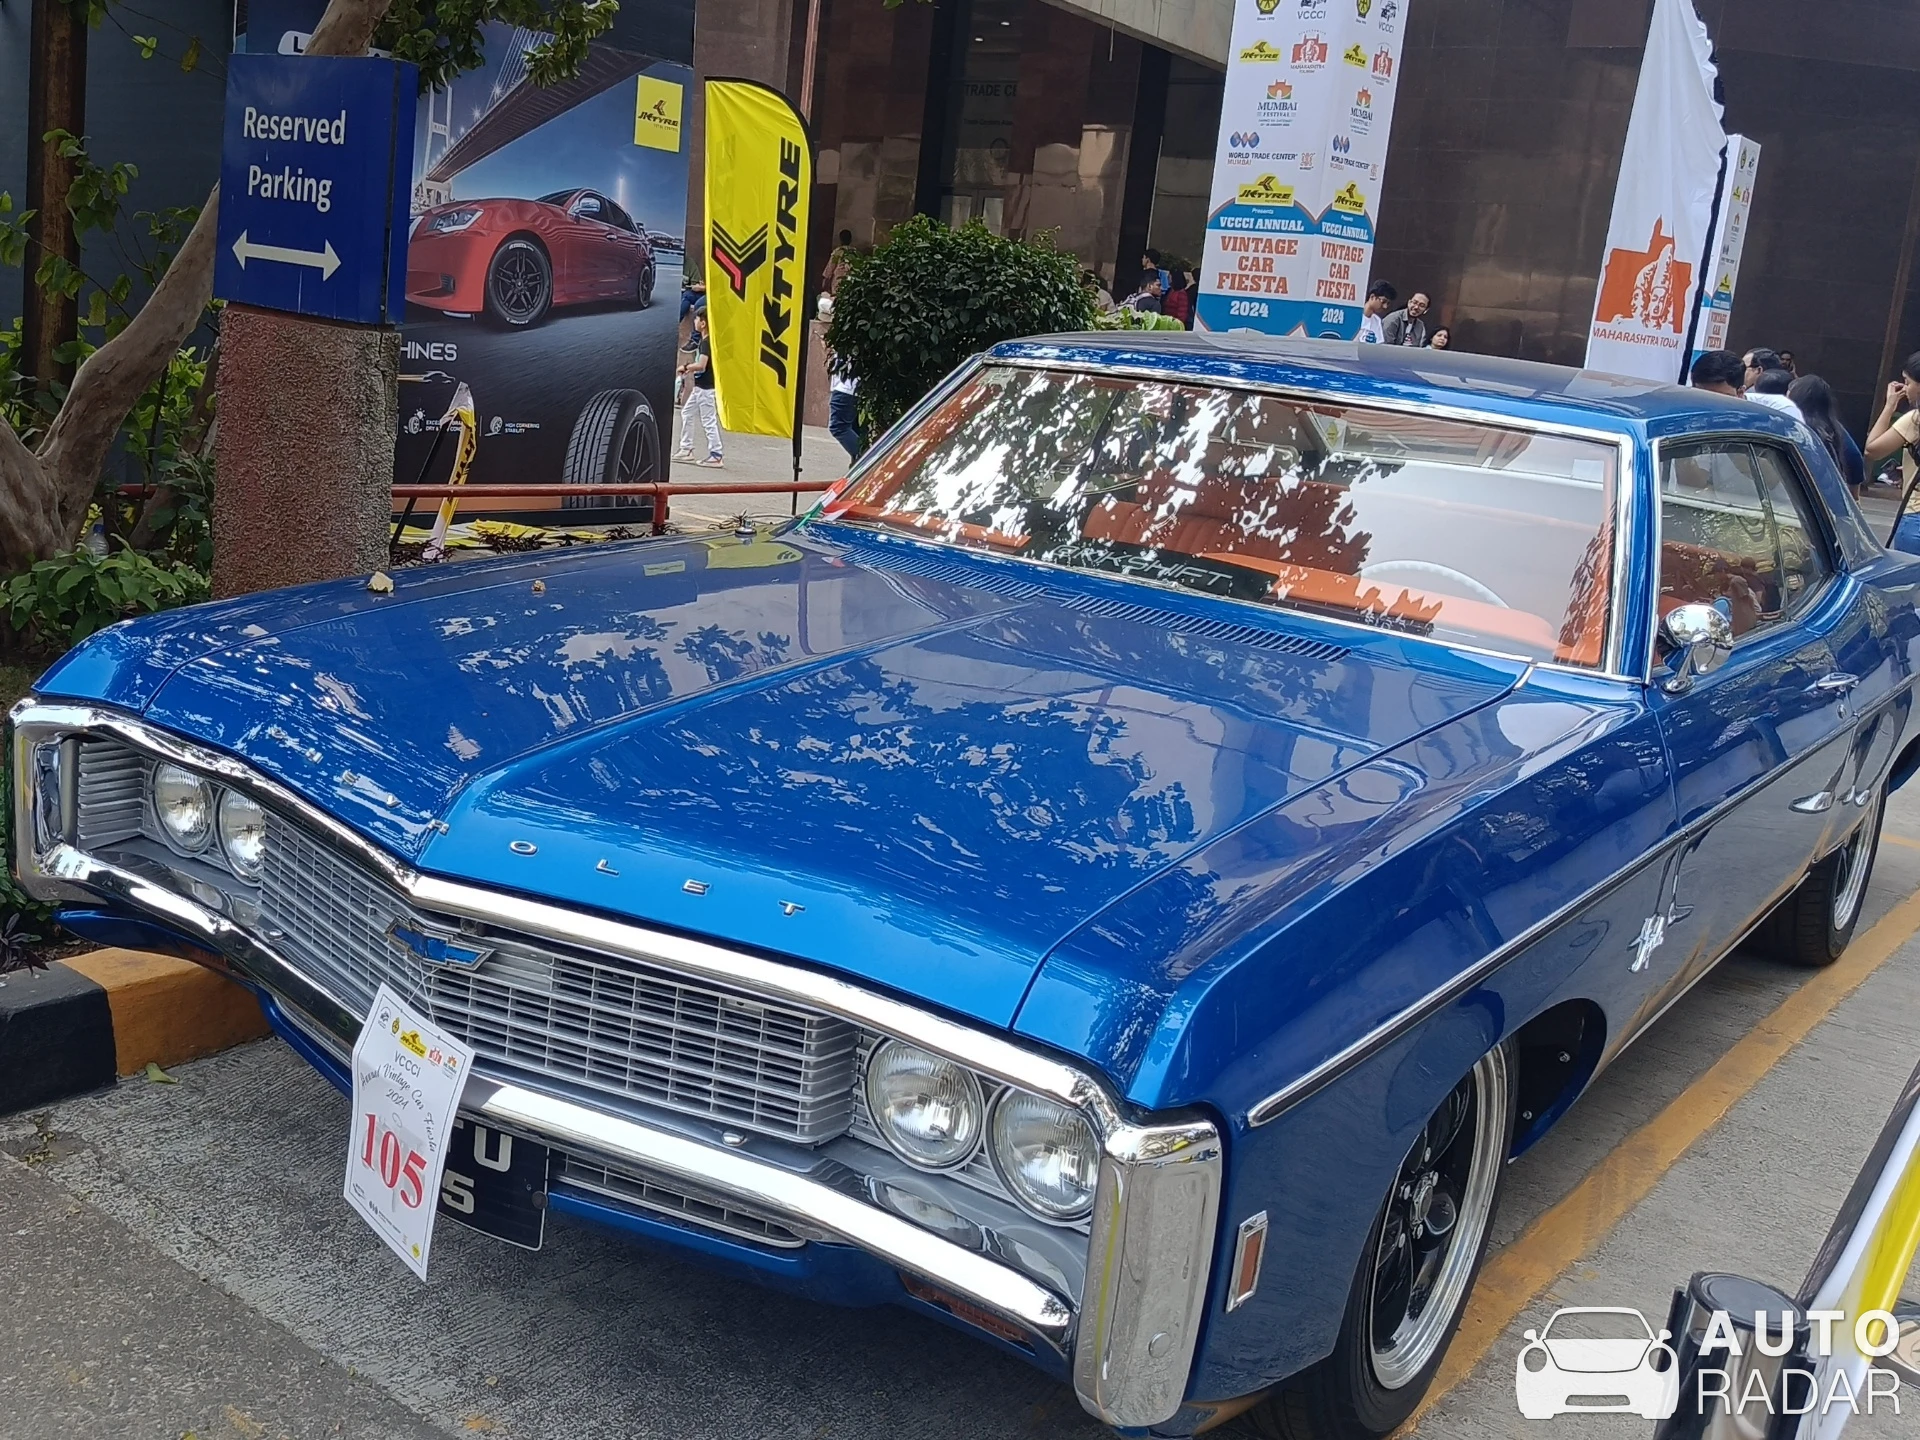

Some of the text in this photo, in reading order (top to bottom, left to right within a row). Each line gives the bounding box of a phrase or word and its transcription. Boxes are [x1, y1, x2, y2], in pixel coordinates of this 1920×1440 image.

[1297, 10, 1326, 20] VCCCI
[965, 84, 1001, 97] TRADE
[1257, 102, 1298, 111] MUMBAI
[243, 106, 347, 145] Reserved
[1251, 152, 1270, 160] TRADE
[247, 164, 332, 213] Parking
[1252, 207, 1274, 215] Presents
[1219, 216, 1304, 232] VCCCI ANNUAL
[1321, 221, 1369, 240] VCCCI ANNUAL
[1220, 235, 1299, 255] VINTAGE
[1321, 241, 1364, 263] VINTAGE
[1237, 255, 1274, 273] CAR
[1329, 262, 1350, 280] CAR
[1216, 272, 1289, 295] FIESTA
[1315, 279, 1356, 301] FIESTA
[1229, 300, 1269, 318] 2024
[1321, 307, 1344, 325] 2024
[394, 1050, 421, 1077] VCCCI
[383, 1063, 411, 1091] Vintage
[411, 1089, 424, 1110] Car
[423, 1112, 437, 1152] Fiesta
[385, 1088, 410, 1110] 2024
[361, 1113, 428, 1209] 105
